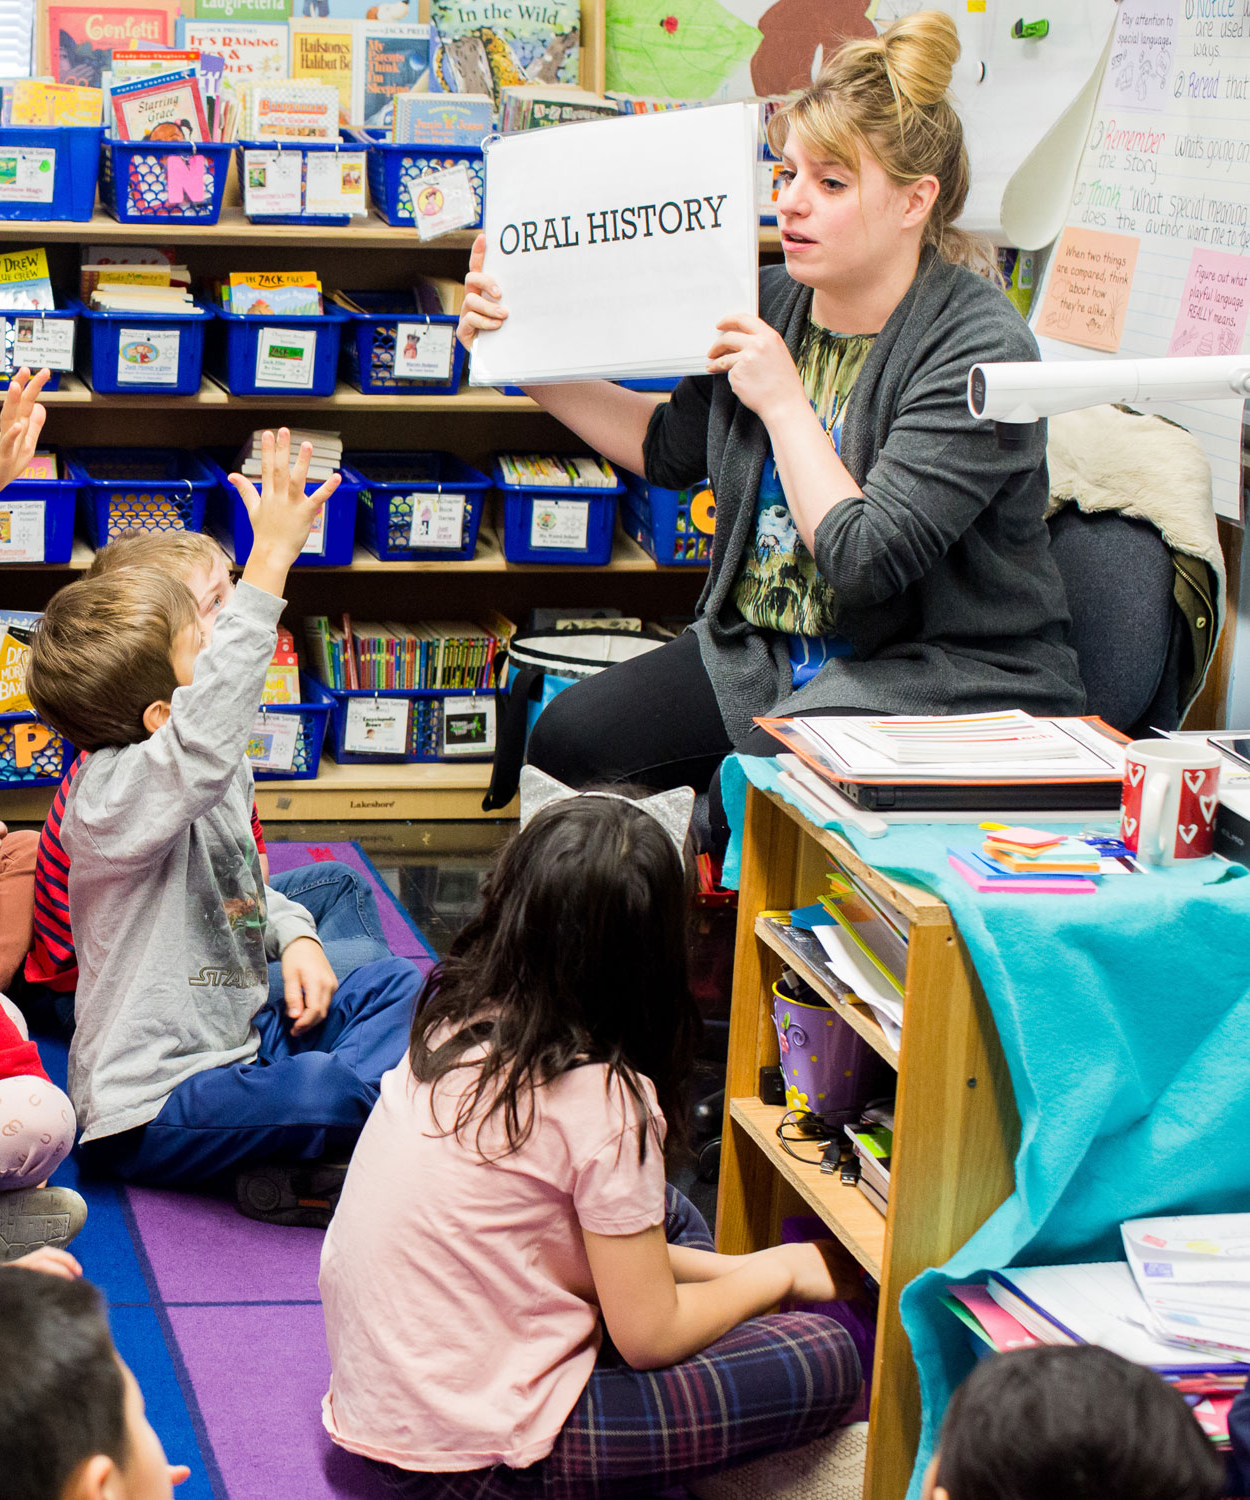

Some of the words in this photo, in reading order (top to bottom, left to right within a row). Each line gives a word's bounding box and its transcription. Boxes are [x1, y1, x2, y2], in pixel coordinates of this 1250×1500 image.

[458, 8, 478, 23] In
[483, 2, 512, 20] the
[518, 4, 559, 26] Wild
[1121, 12, 1134, 29] Pay
[1134, 13, 1166, 28] attention
[1167, 16, 1174, 27] to
[86, 15, 159, 40] Confetti
[1195, 20, 1214, 38] are
[1220, 16, 1244, 38] used
[222, 36, 279, 49] RAINING
[300, 38, 350, 54] Hailstones
[368, 39, 385, 55] My
[1117, 33, 1139, 46] special
[301, 54, 337, 70] Halibut
[138, 95, 179, 114] Starring
[148, 107, 174, 123] Grace
[167, 155, 205, 204] N
[500, 216, 579, 256] ORAL
[586, 194, 727, 245] HISTORY
[1081, 204, 1107, 227] does
[1116, 211, 1136, 231] the
[1145, 218, 1184, 238] author
[4, 252, 40, 272] DREW
[1065, 246, 1086, 259] When
[1087, 249, 1101, 263] two
[1103, 252, 1127, 267] things
[258, 275, 285, 286] ZACK
[1056, 264, 1069, 275] are
[1109, 270, 1128, 284] think
[1194, 264, 1215, 284] Figure
[1217, 271, 1230, 283] out
[1230, 272, 1248, 287] what
[1068, 281, 1091, 297] about
[1092, 284, 1106, 298] how
[1060, 298, 1085, 315] they're
[1214, 289, 1244, 312] language
[1188, 304, 1213, 323] REALLY
[14, 723, 50, 768] P
